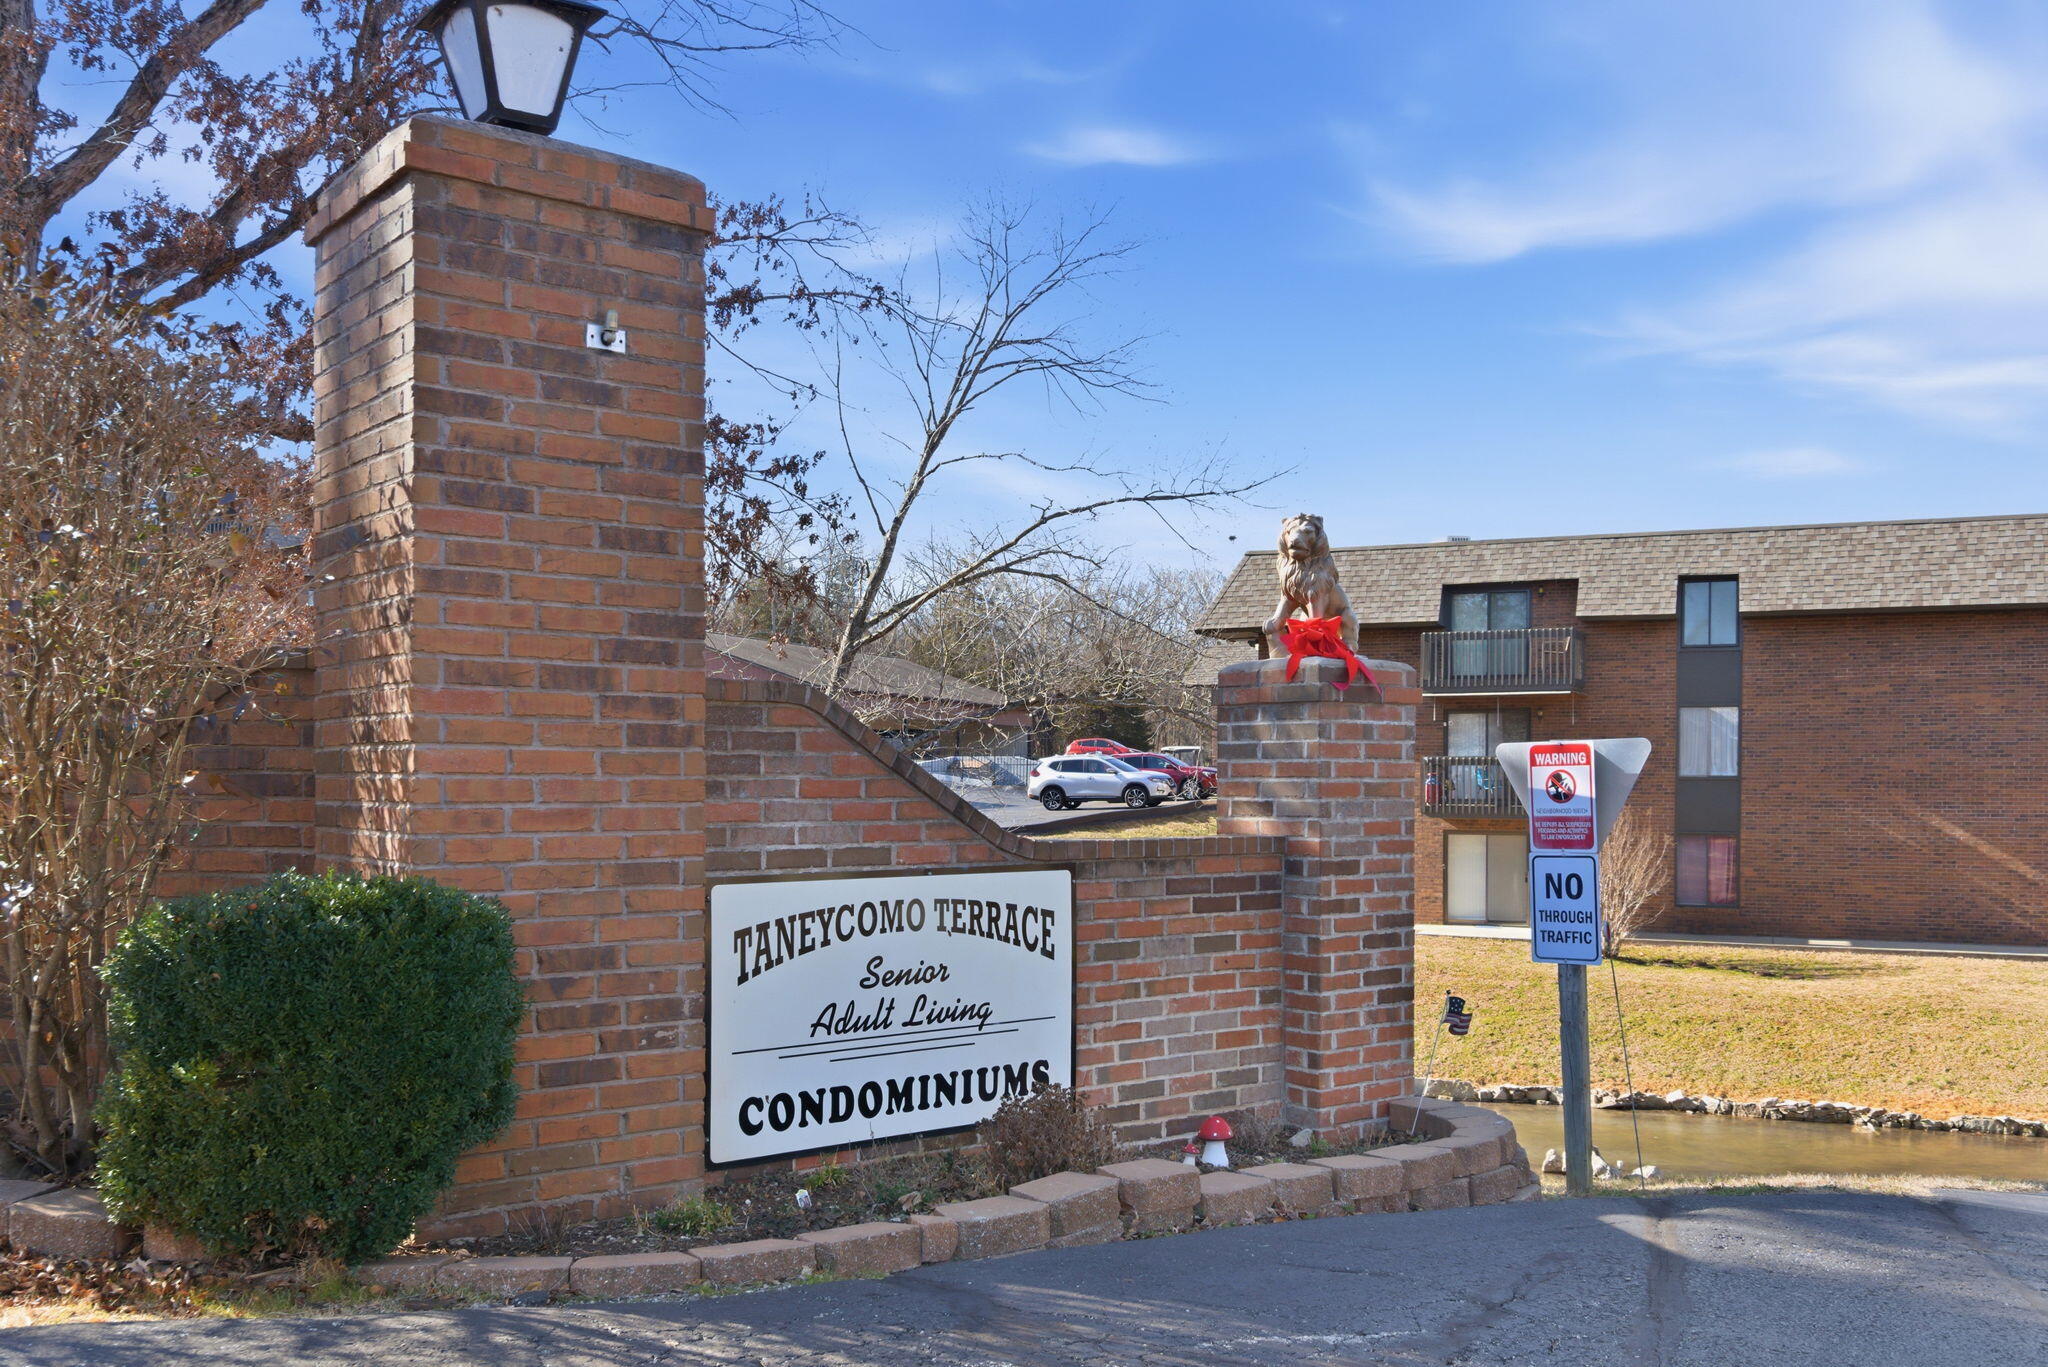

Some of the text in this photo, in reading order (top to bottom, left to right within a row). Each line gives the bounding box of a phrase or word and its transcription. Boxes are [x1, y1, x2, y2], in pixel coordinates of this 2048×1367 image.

[1535, 753, 1586, 765] WARNING
[1545, 873, 1583, 899] NO
[1539, 910, 1592, 924] THROUGH
[733, 898, 1056, 986] TANEYCOMO TERRACE
[1540, 930, 1592, 944] TRAFFIC
[859, 956, 950, 989] Senior
[810, 994, 993, 1037] Adult Living
[738, 1059, 1050, 1136] CONDOMINIUMS
